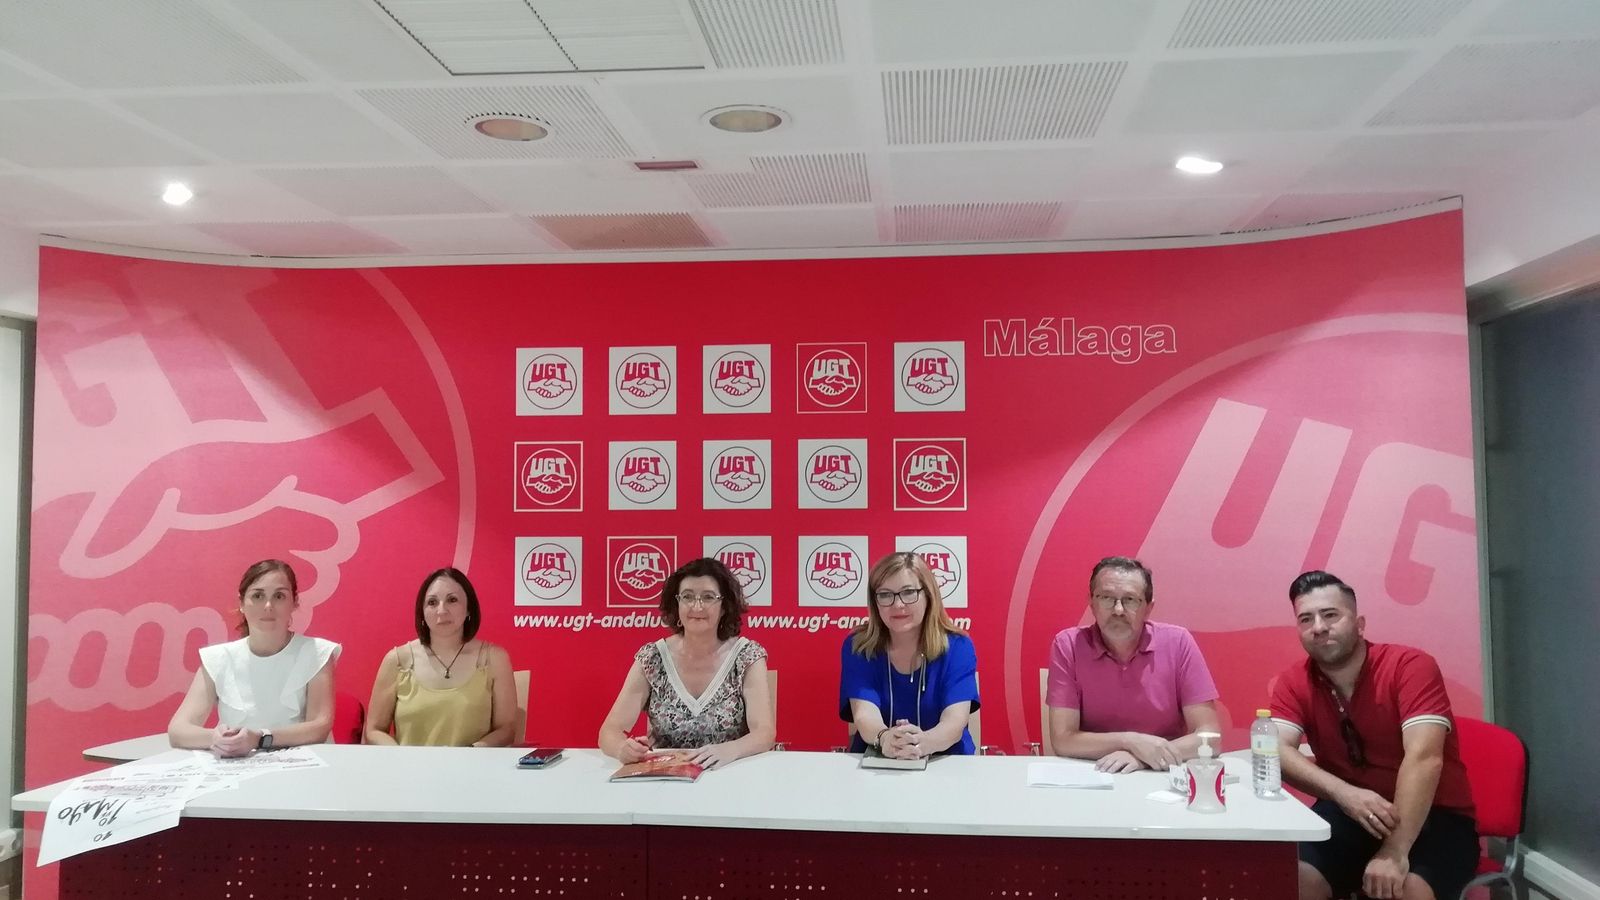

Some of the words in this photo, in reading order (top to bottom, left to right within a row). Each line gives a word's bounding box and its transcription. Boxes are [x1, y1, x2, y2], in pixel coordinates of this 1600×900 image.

[983, 317, 1178, 365] Málaga
[531, 362, 567, 382] UGT
[624, 361, 661, 381] UGT
[718, 360, 755, 380] UGT
[813, 358, 851, 379] UGT
[910, 357, 949, 378] UGT
[529, 457, 567, 476] UGT
[624, 456, 661, 476] UGT
[718, 455, 755, 475] UGT
[813, 454, 851, 474] UGT
[910, 454, 949, 475] UGT
[530, 552, 566, 572] UGT
[622, 552, 661, 572] UGT
[814, 551, 852, 571] UGT
